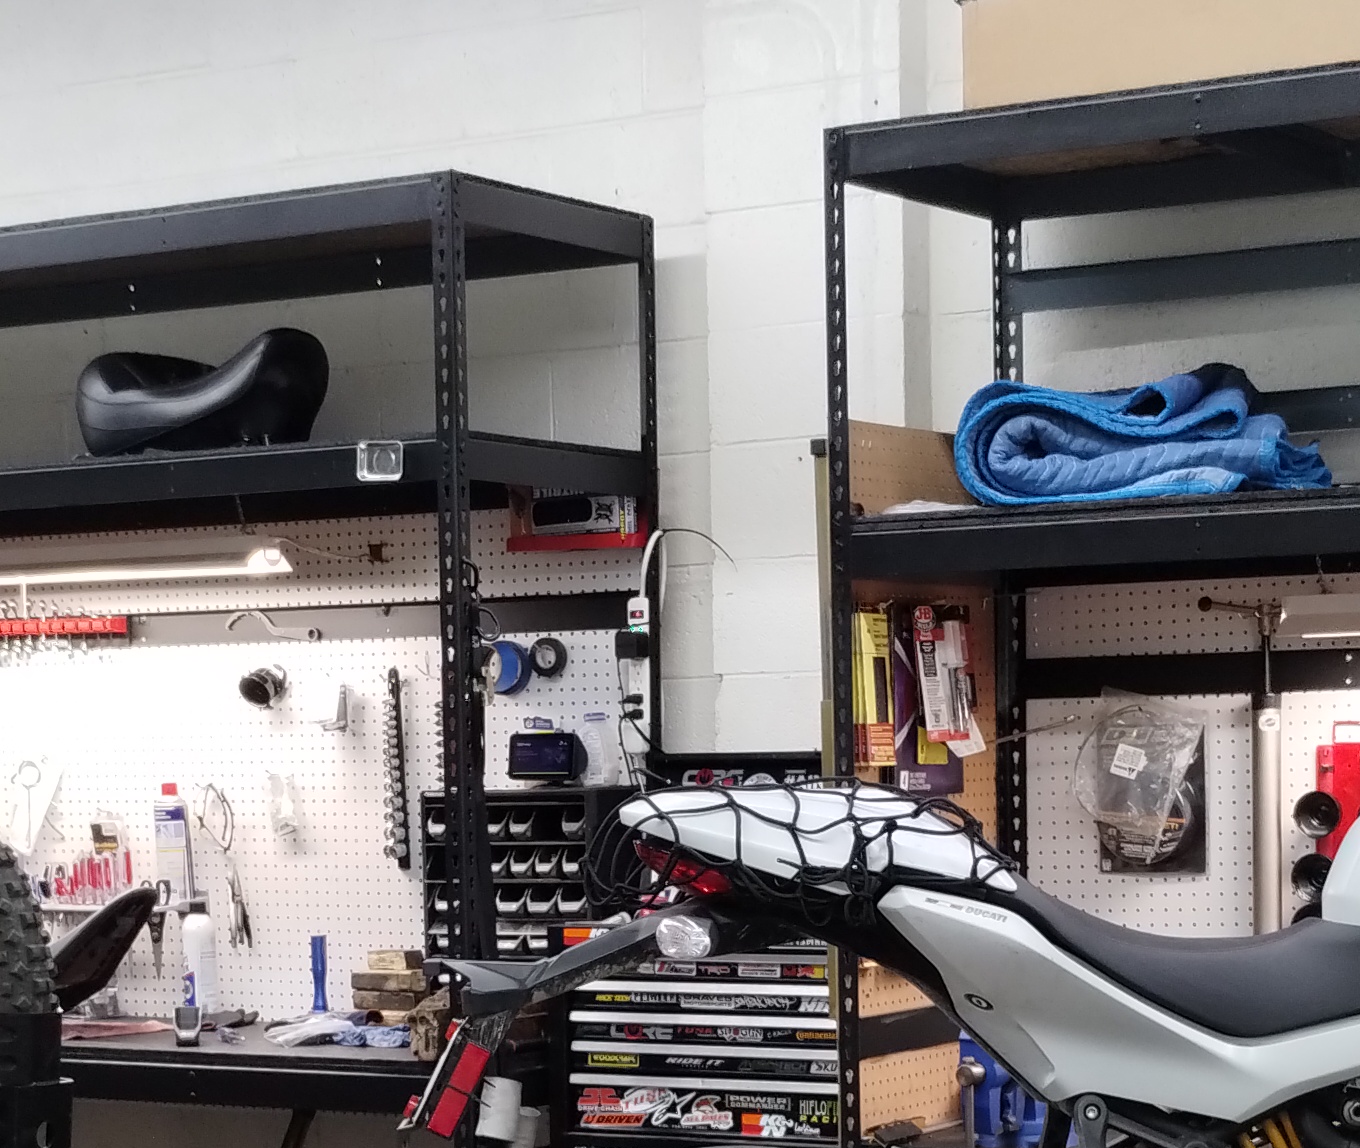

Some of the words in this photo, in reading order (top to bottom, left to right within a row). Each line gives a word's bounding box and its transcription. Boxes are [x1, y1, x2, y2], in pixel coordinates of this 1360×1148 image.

[965, 906, 1008, 923] DUCATI
[796, 1030, 837, 1041] Continenta
[730, 1095, 786, 1104] POWER
[596, 1114, 644, 1124] DRIVEN
[760, 1114, 794, 1137] K&N
